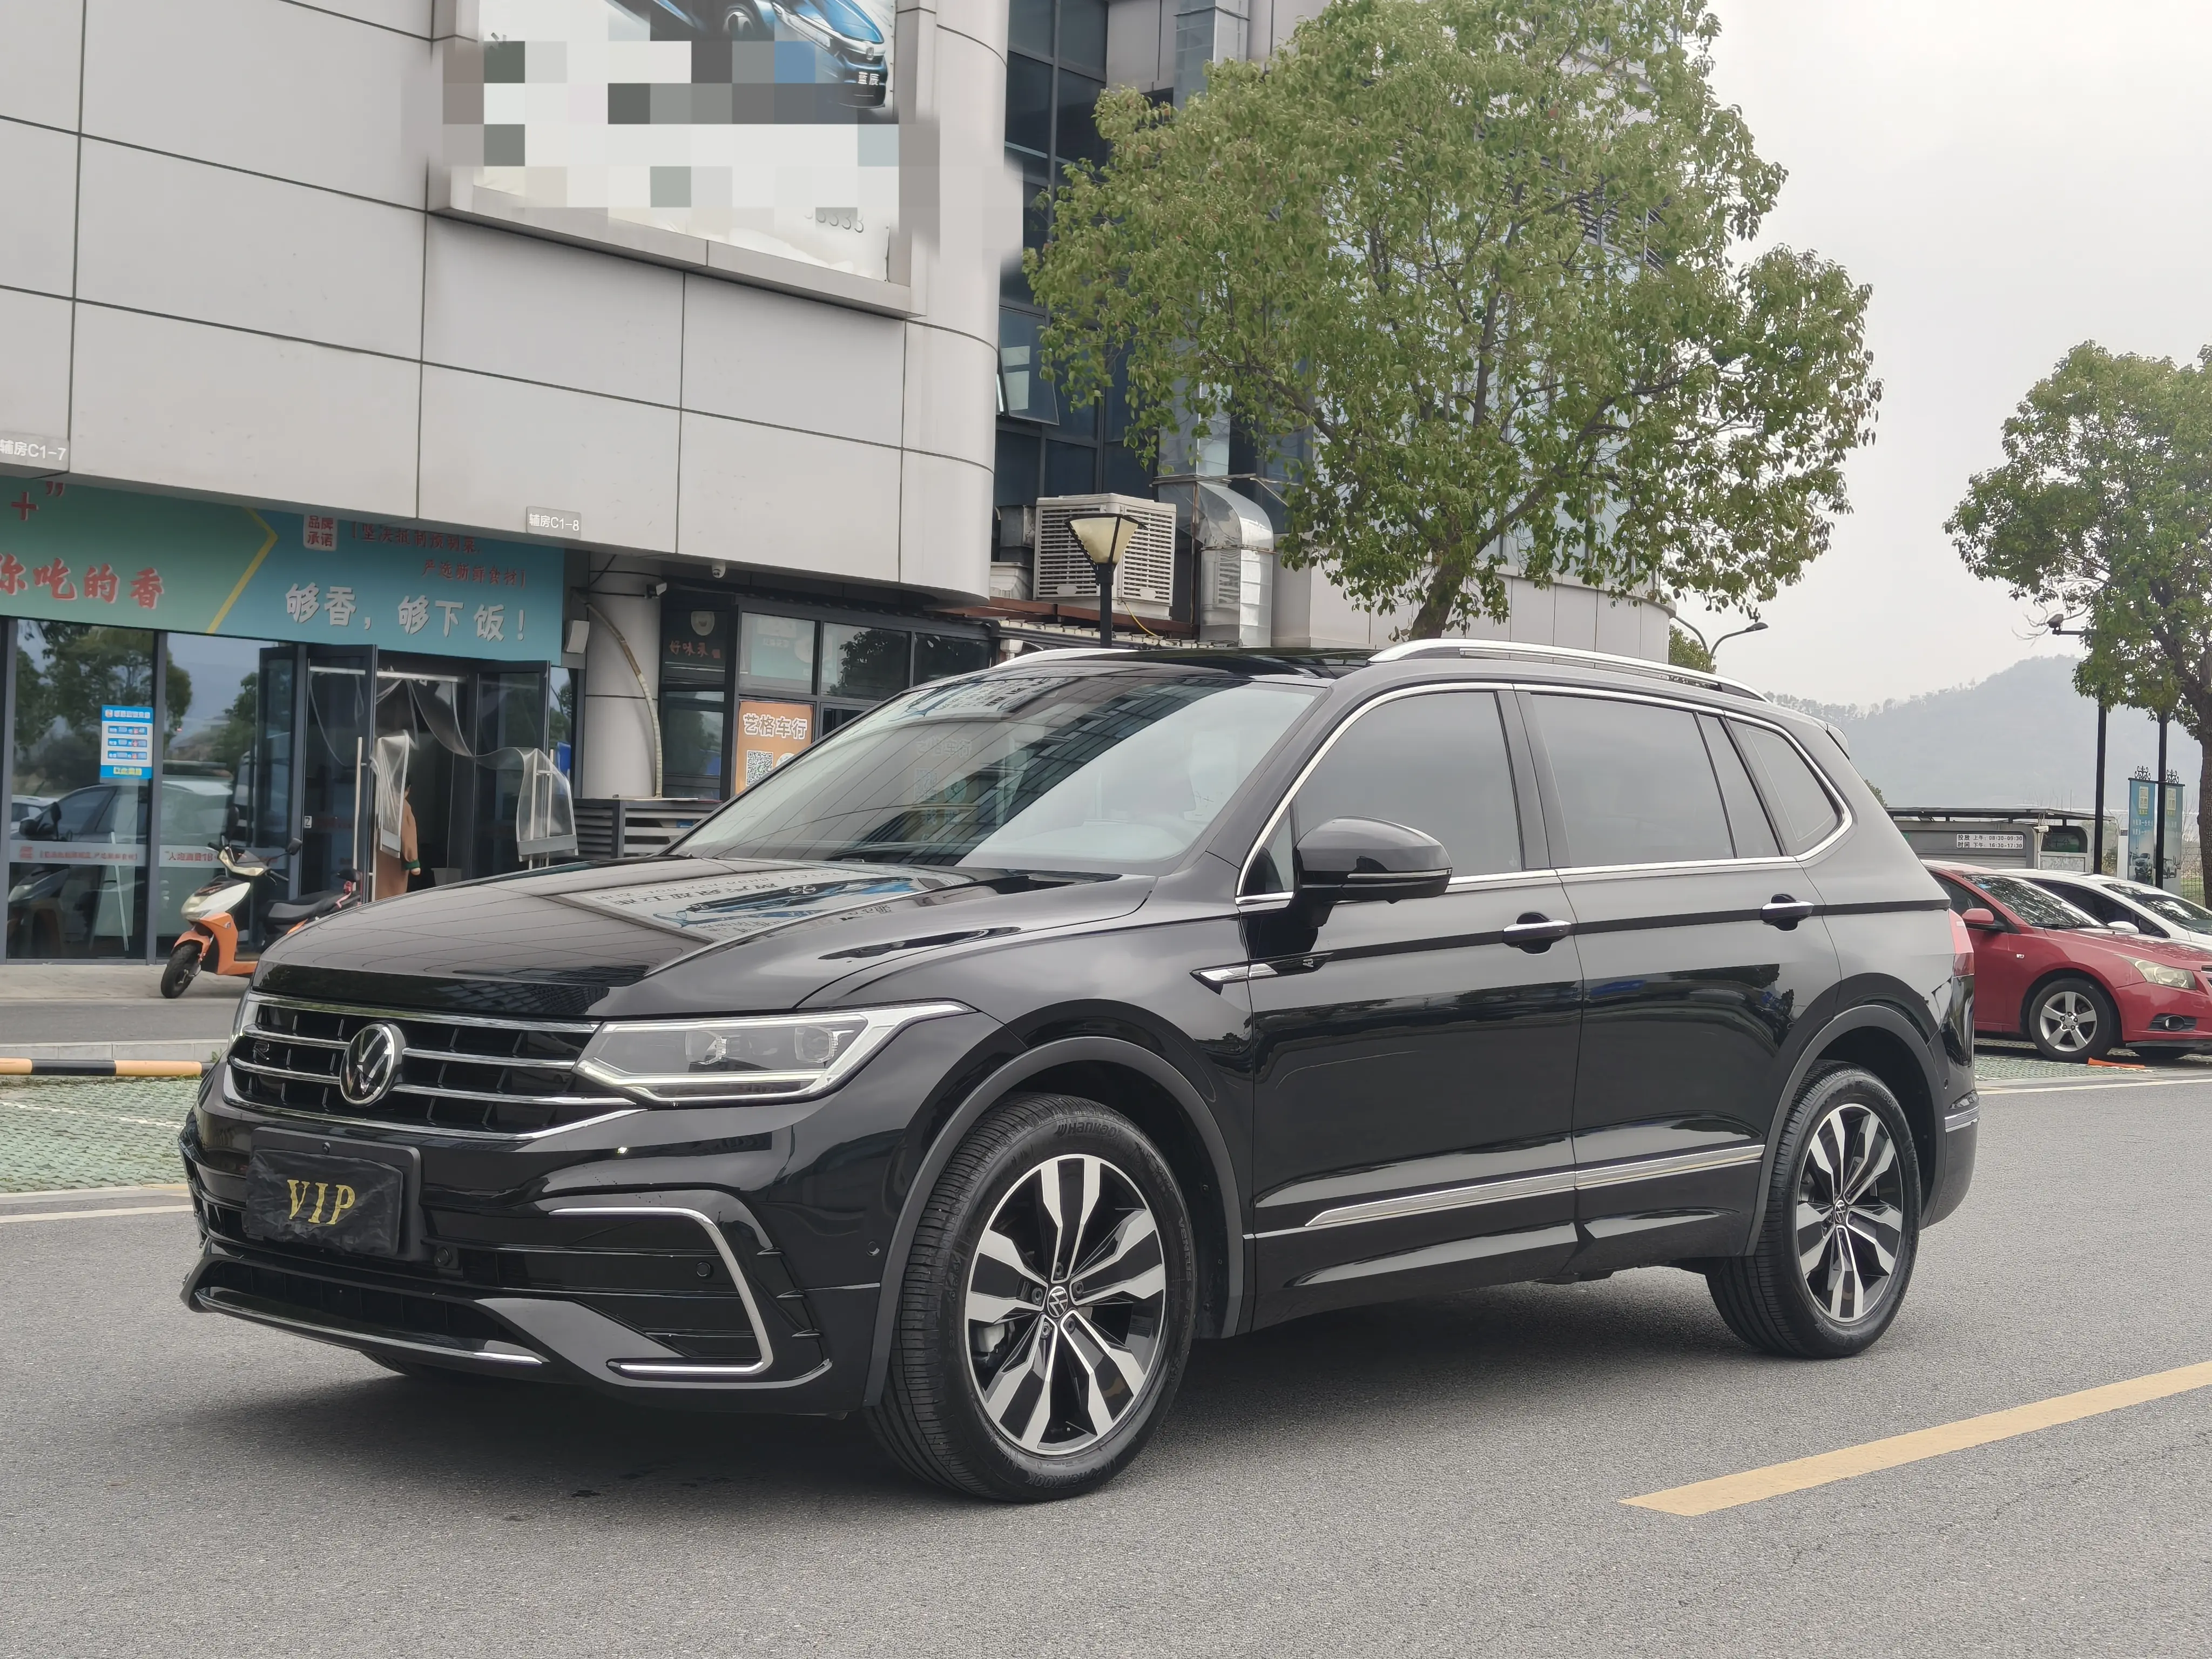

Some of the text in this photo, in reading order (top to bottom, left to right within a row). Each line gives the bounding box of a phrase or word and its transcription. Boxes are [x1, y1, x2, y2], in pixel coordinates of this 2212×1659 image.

[743, 713, 807, 740] 艺格车行
[287, 1179, 355, 1225] VIP
